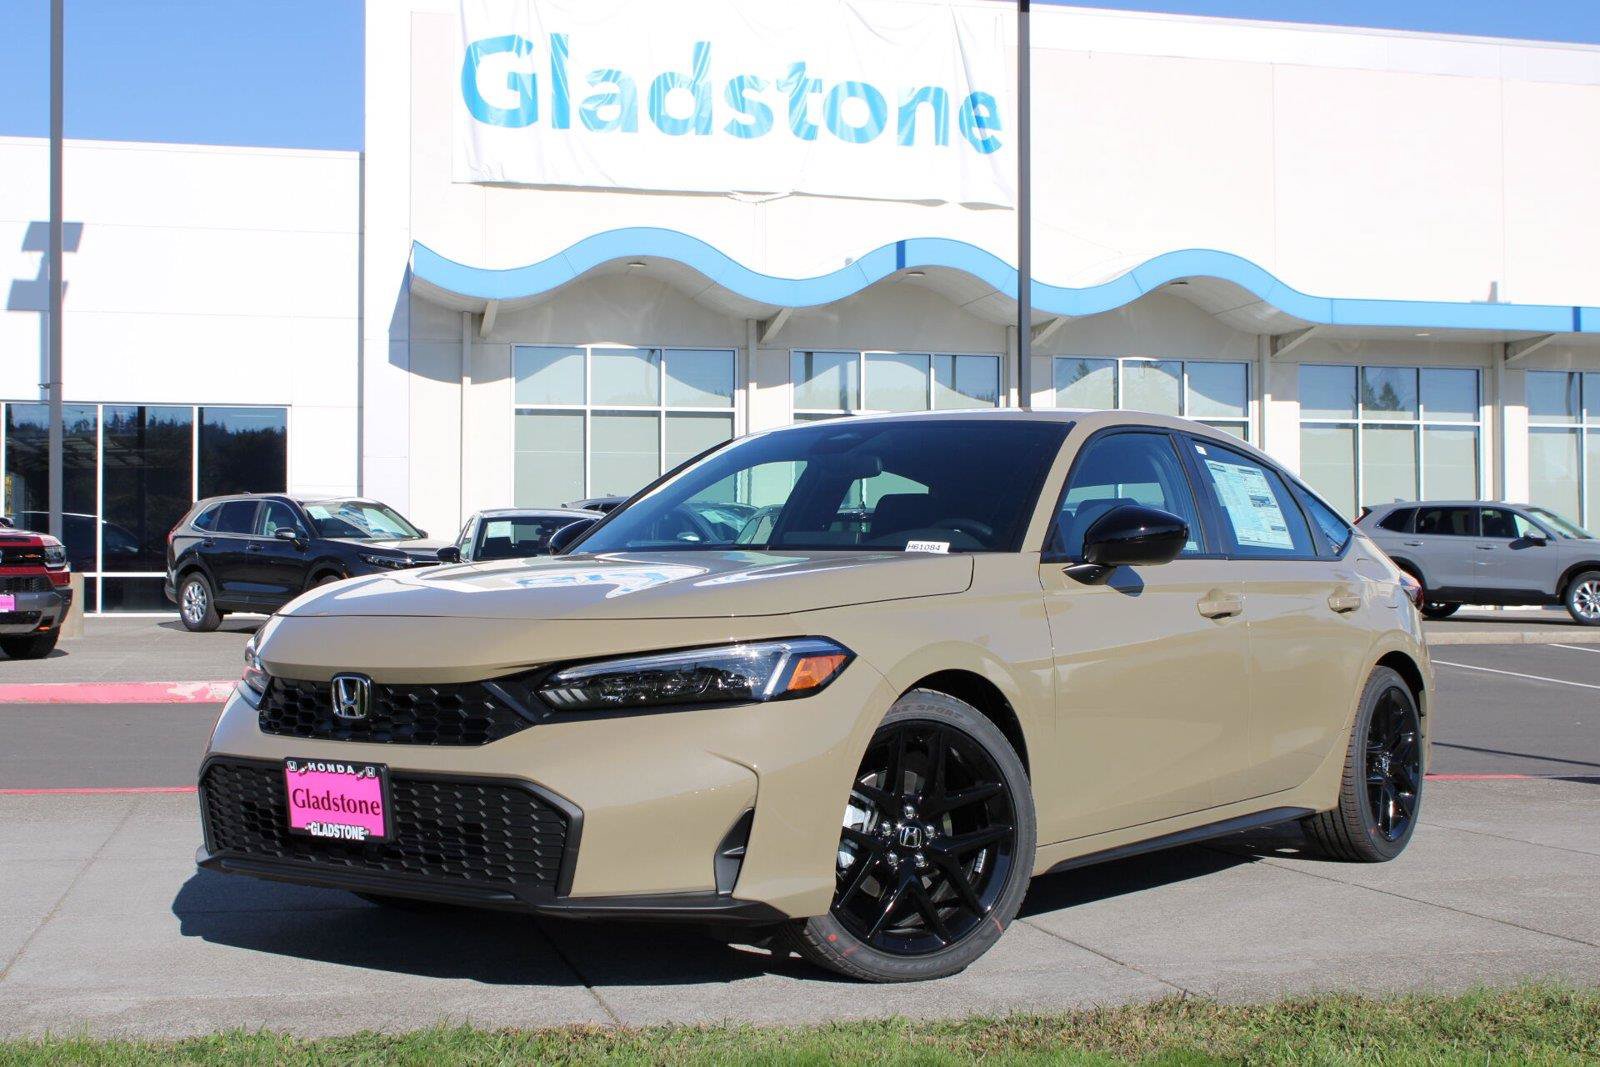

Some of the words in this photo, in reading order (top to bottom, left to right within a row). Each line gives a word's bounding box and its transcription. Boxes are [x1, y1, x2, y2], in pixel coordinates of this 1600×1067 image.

[461, 33, 1004, 155] Gladstone
[308, 762, 355, 774] HONDA
[292, 788, 380, 815] Gladstone
[310, 822, 365, 840] GLADSTONE
